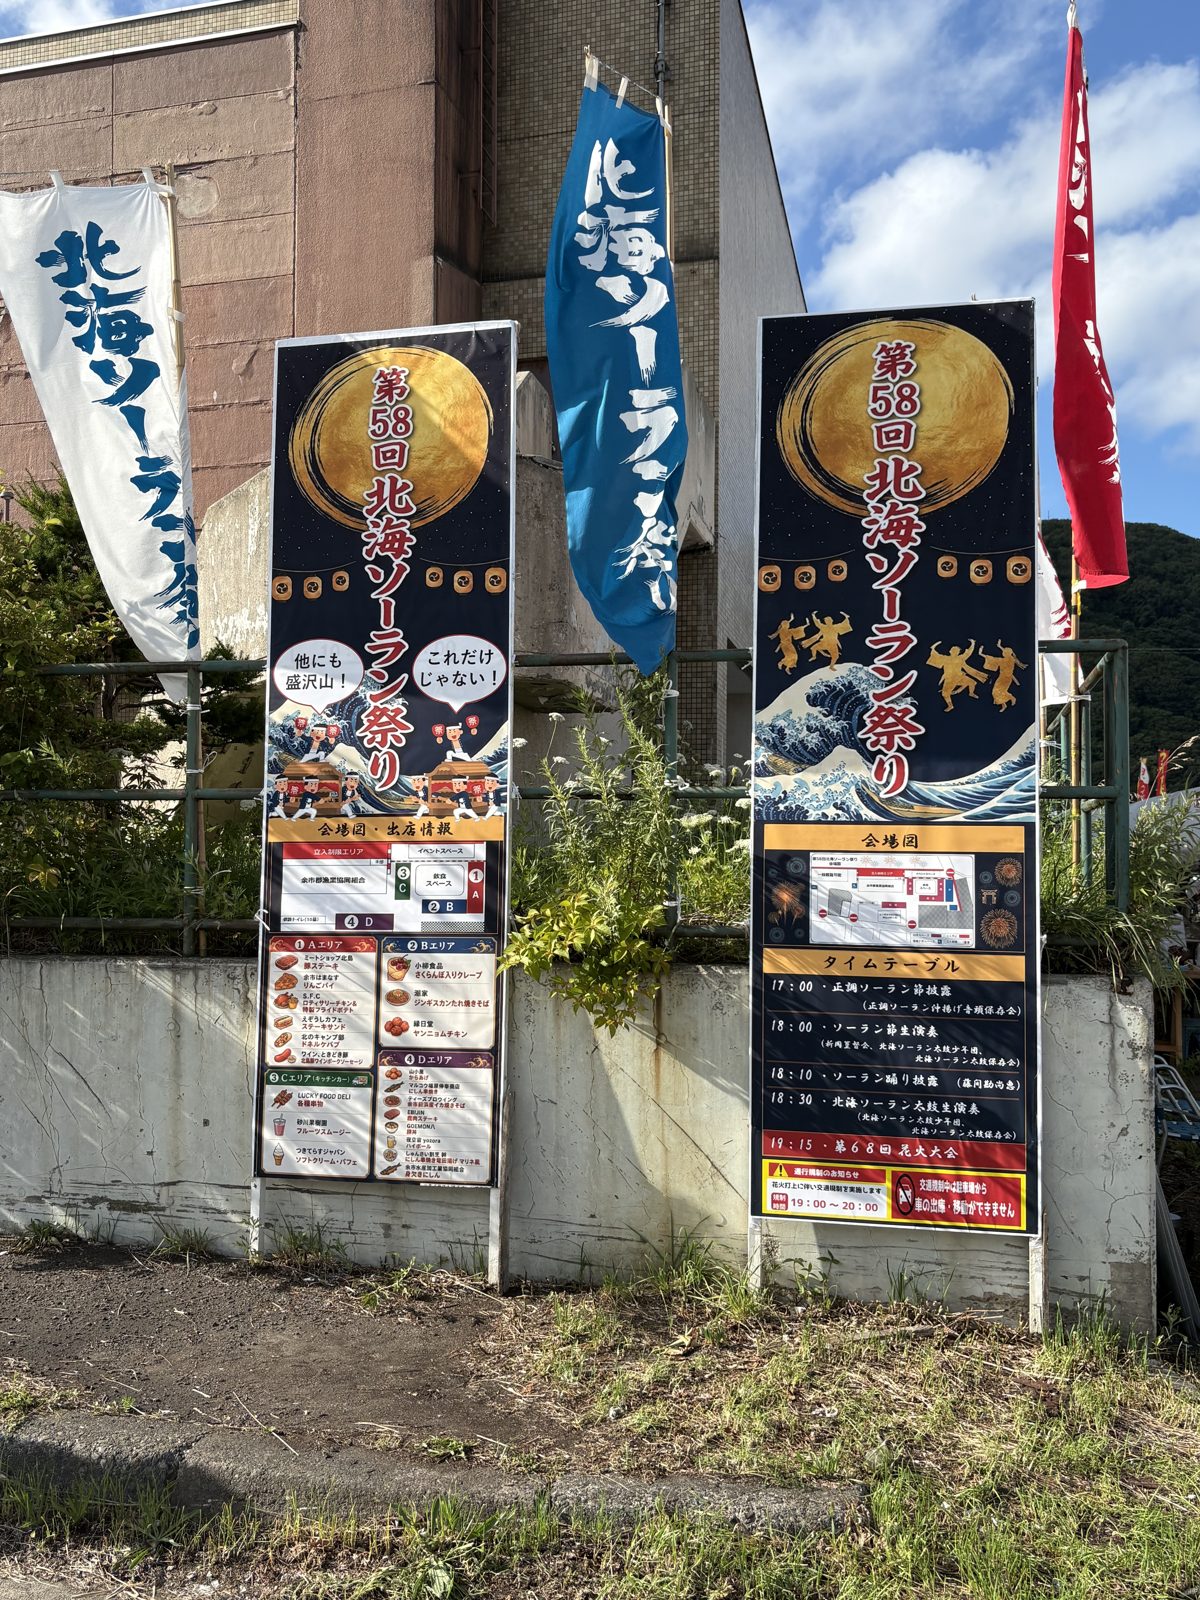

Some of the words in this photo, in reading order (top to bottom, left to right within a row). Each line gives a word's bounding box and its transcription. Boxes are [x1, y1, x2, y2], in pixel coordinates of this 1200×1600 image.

[862, 340, 926, 798] 第58回北海ソーラン祭り
[356, 367, 416, 790] 第58回北海ソーラン祭り
[294, 654, 342, 668] 他にも
[428, 649, 494, 665] これだけ
[286, 674, 346, 690] 盛沢山!
[420, 670, 498, 687] じゃない!
[318, 822, 454, 836] 会場図・出店情報
[862, 833, 918, 849] 会場図
[314, 848, 364, 856] 立入制限エリア
[399, 884, 406, 892] C
[472, 891, 479, 899] A
[446, 902, 454, 911] B
[365, 918, 373, 926] D
[308, 940, 342, 949] Aエリア
[421, 942, 455, 950] Bエリア
[824, 956, 960, 972] タイムテーブル
[415, 971, 482, 979] さくらんぼ入りクレープ
[772, 980, 813, 992] 17:00
[771, 1020, 812, 1032] 18:00
[418, 1056, 452, 1064] Dエリア
[771, 1068, 812, 1080] 18:10
[771, 1093, 812, 1105] 18:30
[771, 1137, 812, 1150] 19:15
[794, 1168, 860, 1179] 通行規制のお知らせ
[920, 1179, 987, 1195] 交通規制中は駐車場から
[914, 1197, 1015, 1218] 車の出庫・移動ができません
